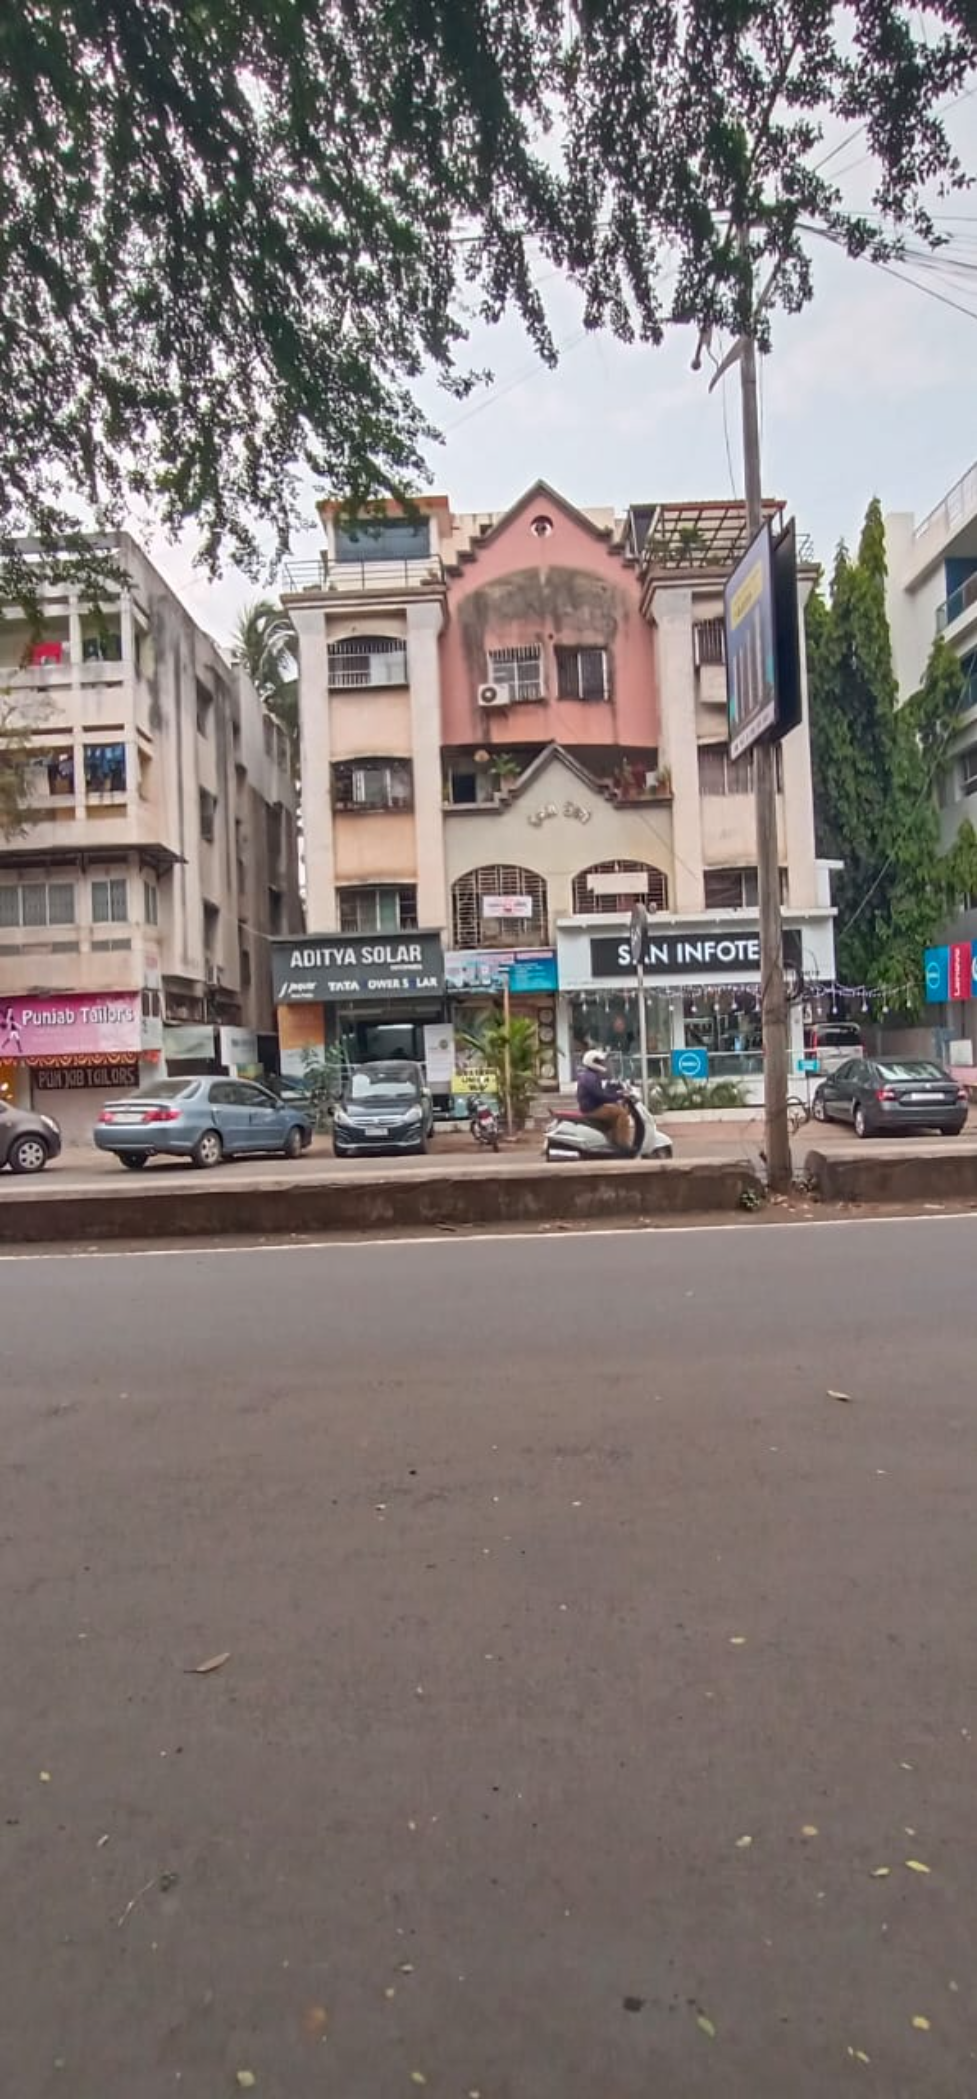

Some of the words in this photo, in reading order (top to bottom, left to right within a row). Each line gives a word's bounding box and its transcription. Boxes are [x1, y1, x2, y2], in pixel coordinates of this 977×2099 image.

[290, 949, 356, 968] ADITYA
[362, 945, 422, 964] SOLAR
[618, 943, 669, 966] SN
[677, 939, 760, 963] INFOTE
[328, 980, 360, 991] TATA
[22, 1008, 75, 1026] Punjab
[80, 1006, 133, 1023] Tailors
